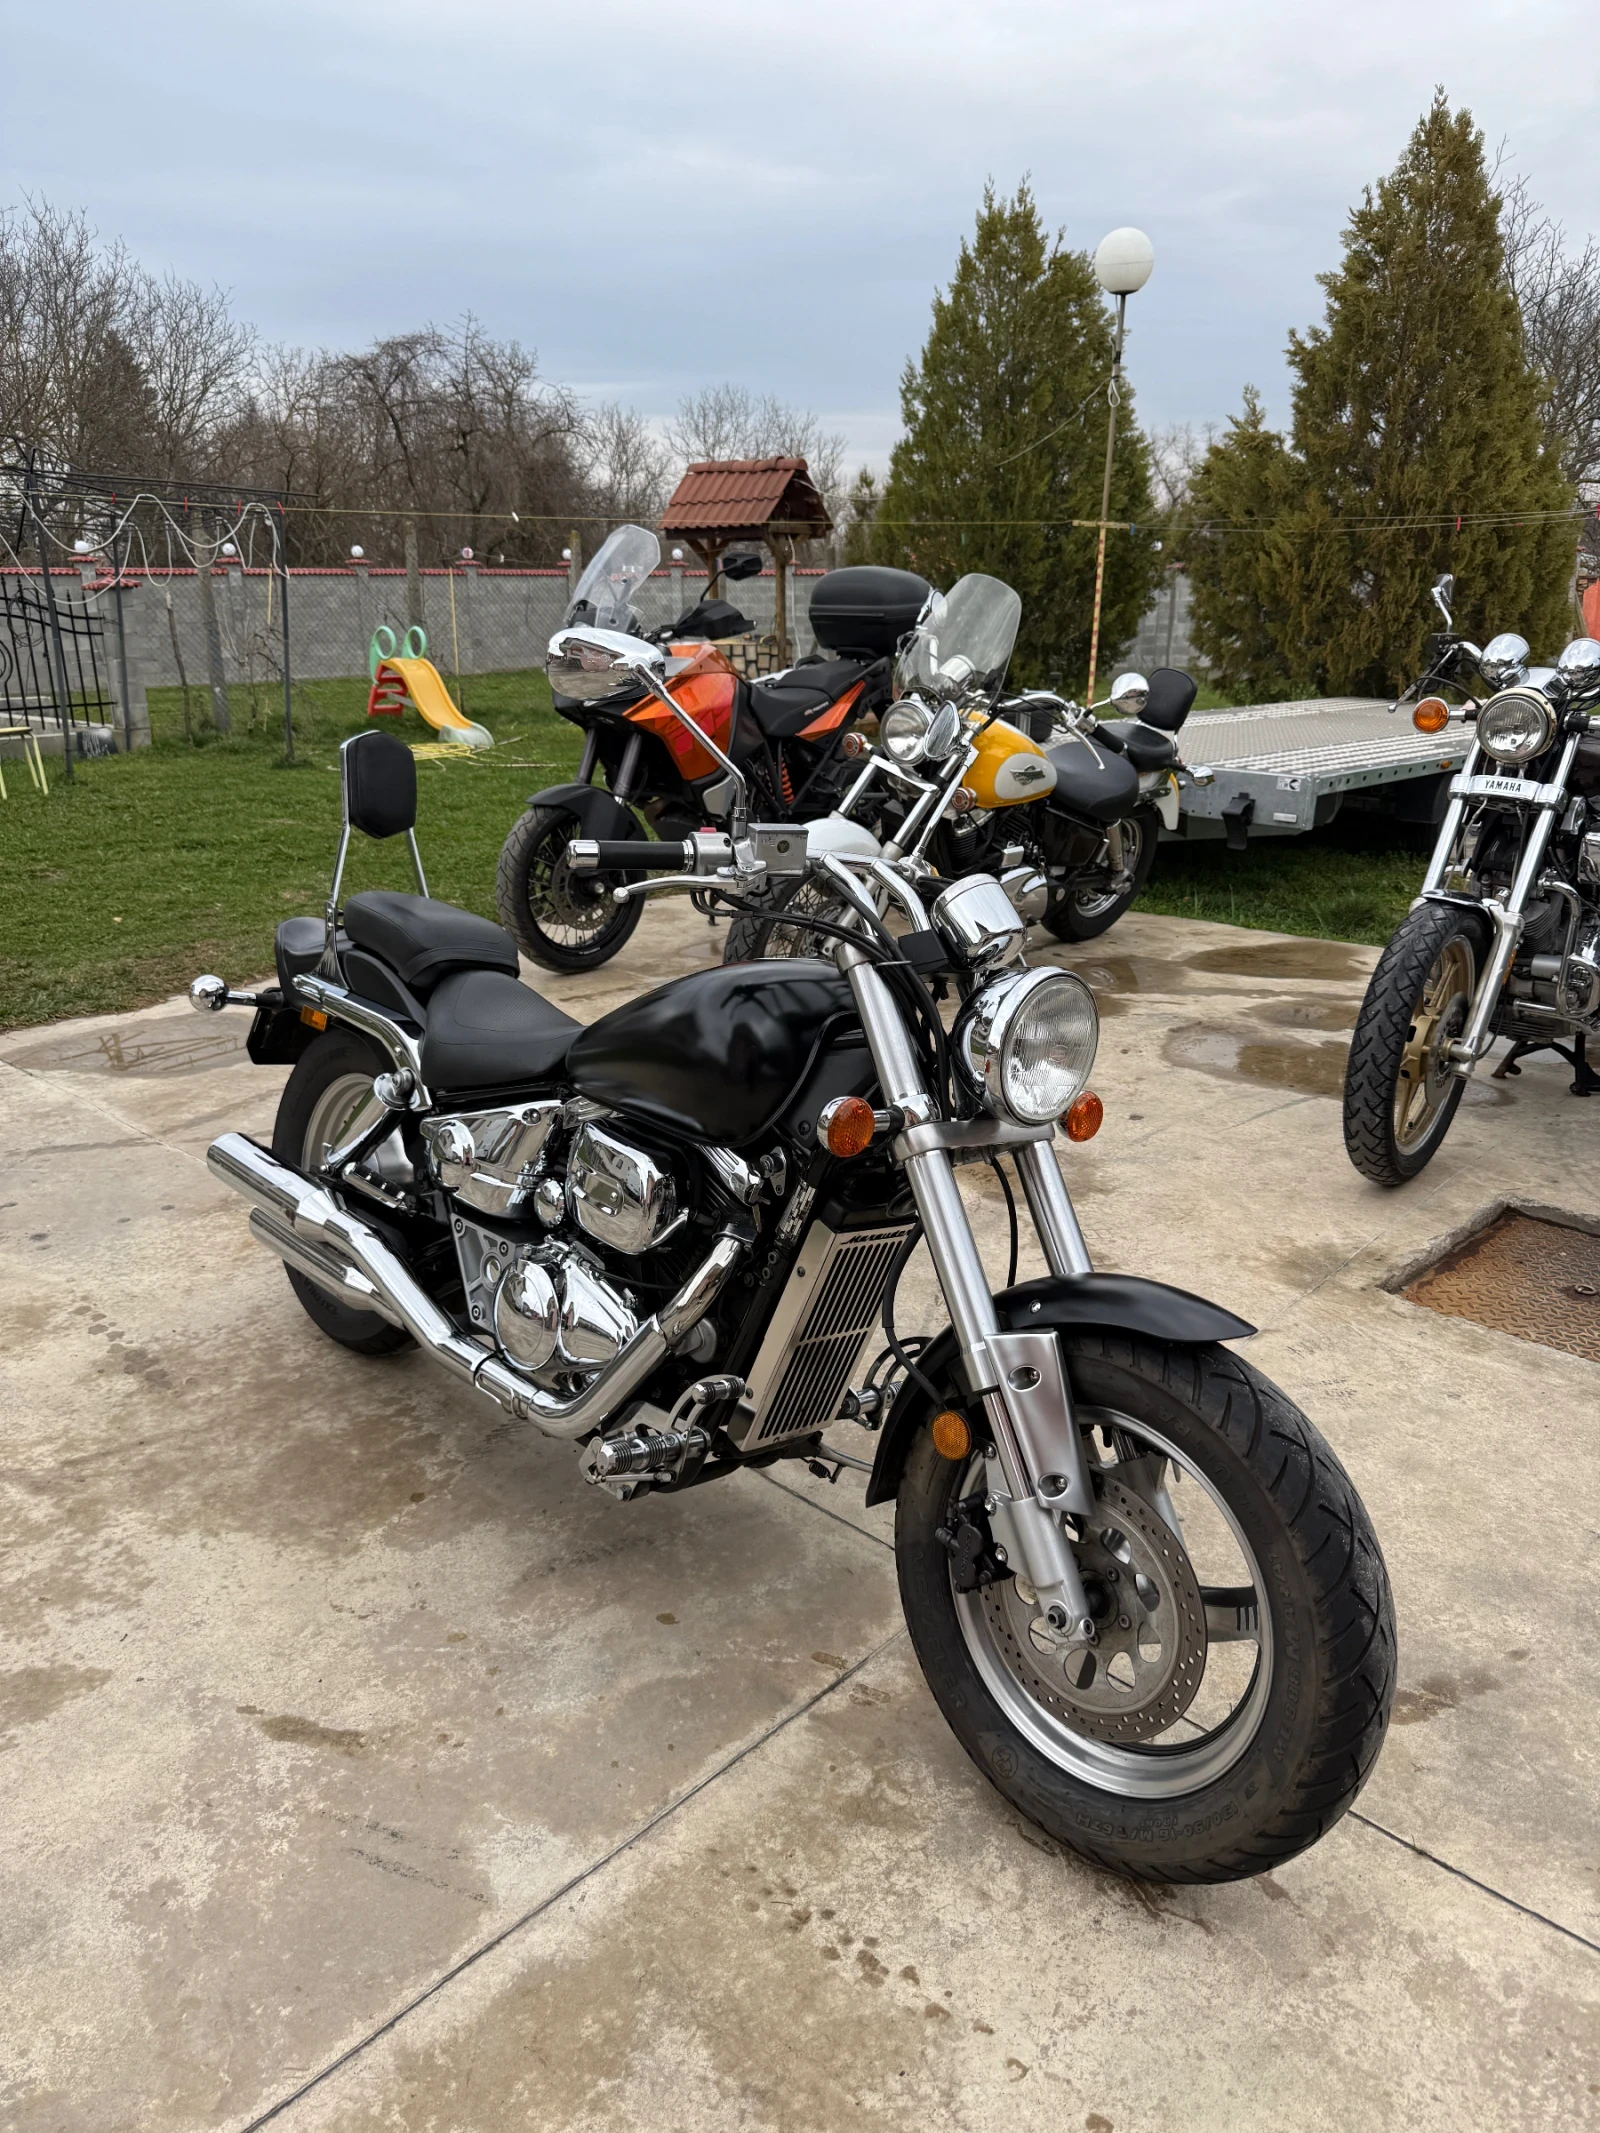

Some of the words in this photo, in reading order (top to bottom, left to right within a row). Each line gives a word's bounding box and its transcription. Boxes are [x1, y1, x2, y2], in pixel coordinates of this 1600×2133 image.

[1485, 780, 1521, 792] YAMAHA
[1273, 1723, 1293, 1763] ME
[1284, 1669, 1300, 1721] 888
[1139, 1816, 1178, 1827] FRONT
